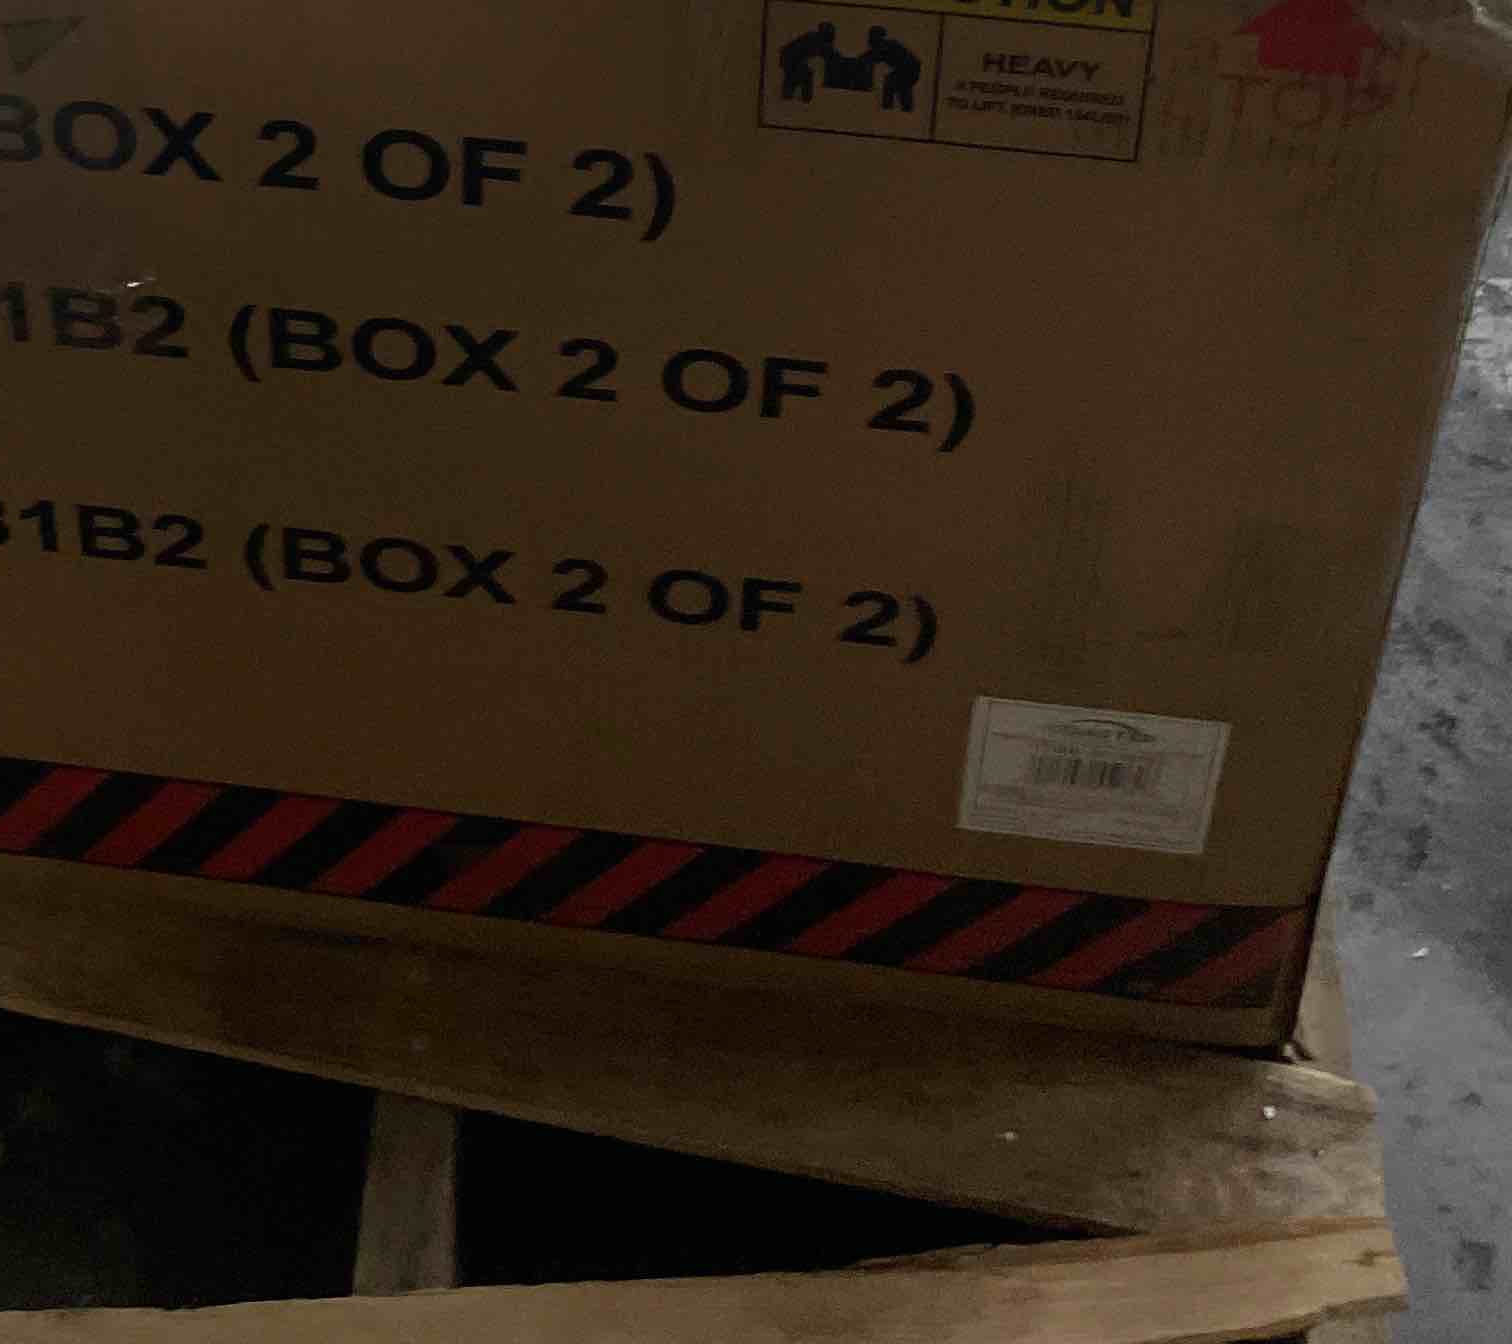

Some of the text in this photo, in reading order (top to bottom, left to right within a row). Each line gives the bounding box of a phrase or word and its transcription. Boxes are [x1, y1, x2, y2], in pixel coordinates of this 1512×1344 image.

[983, 53, 1101, 83] HEAVY
[257, 119, 320, 192] 2
[362, 127, 529, 207] OF
[569, 148, 677, 243] 2)
[228, 303, 520, 392] (BOX
[557, 338, 621, 403] 2
[661, 349, 829, 419] OF
[866, 368, 977, 454] 2)
[244, 522, 518, 605] (BOX
[550, 558, 610, 616] 2
[647, 568, 804, 633] OF
[837, 590, 939, 666] 2)
